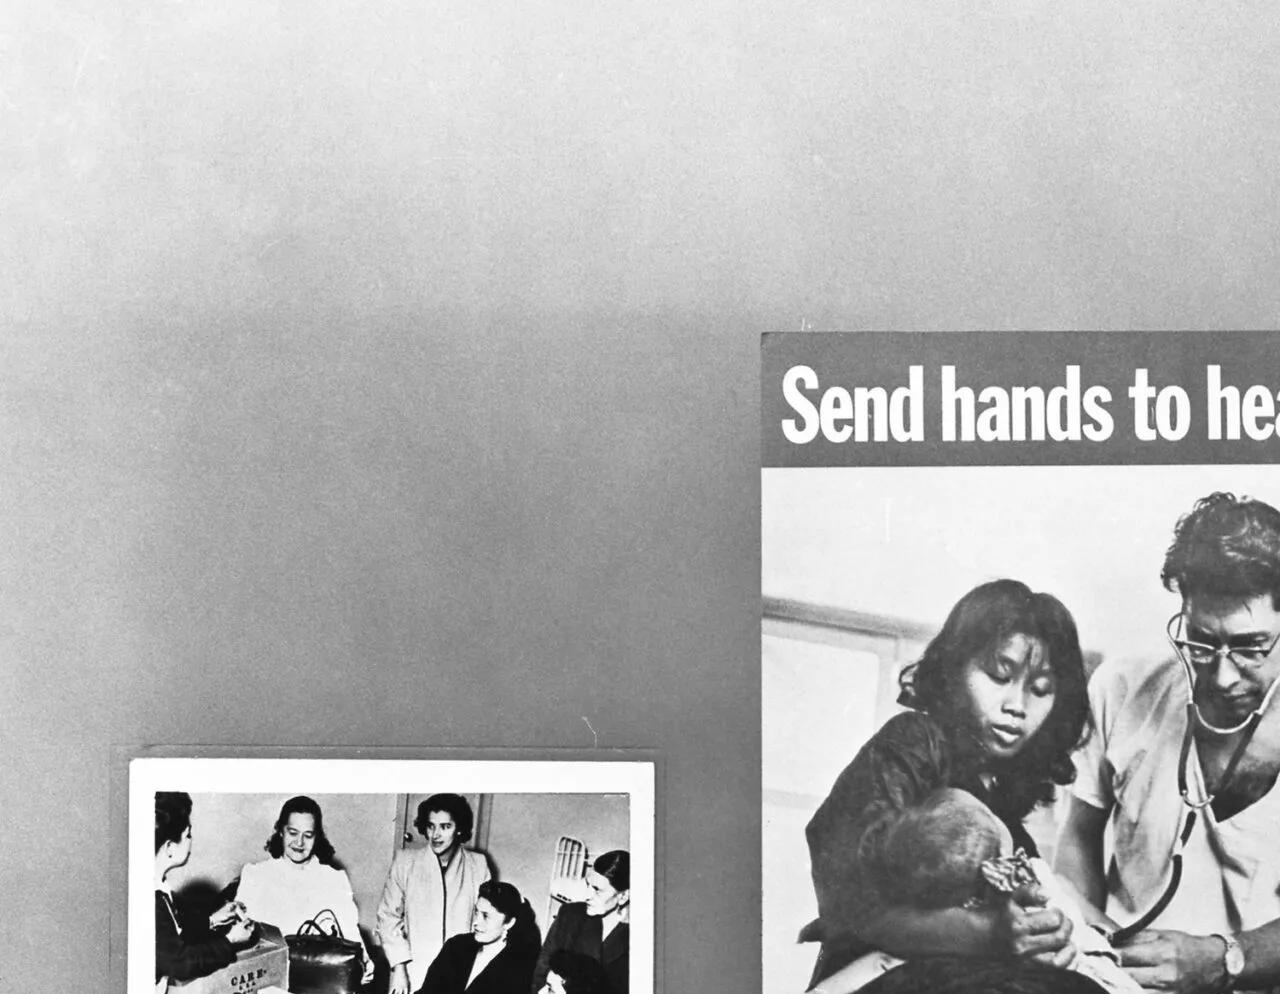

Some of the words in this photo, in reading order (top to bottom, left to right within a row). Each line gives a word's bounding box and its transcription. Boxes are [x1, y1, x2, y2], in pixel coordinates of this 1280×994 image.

[781, 365, 924, 444] Send
[941, 365, 1114, 442] hands
[1128, 368, 1191, 441] to
